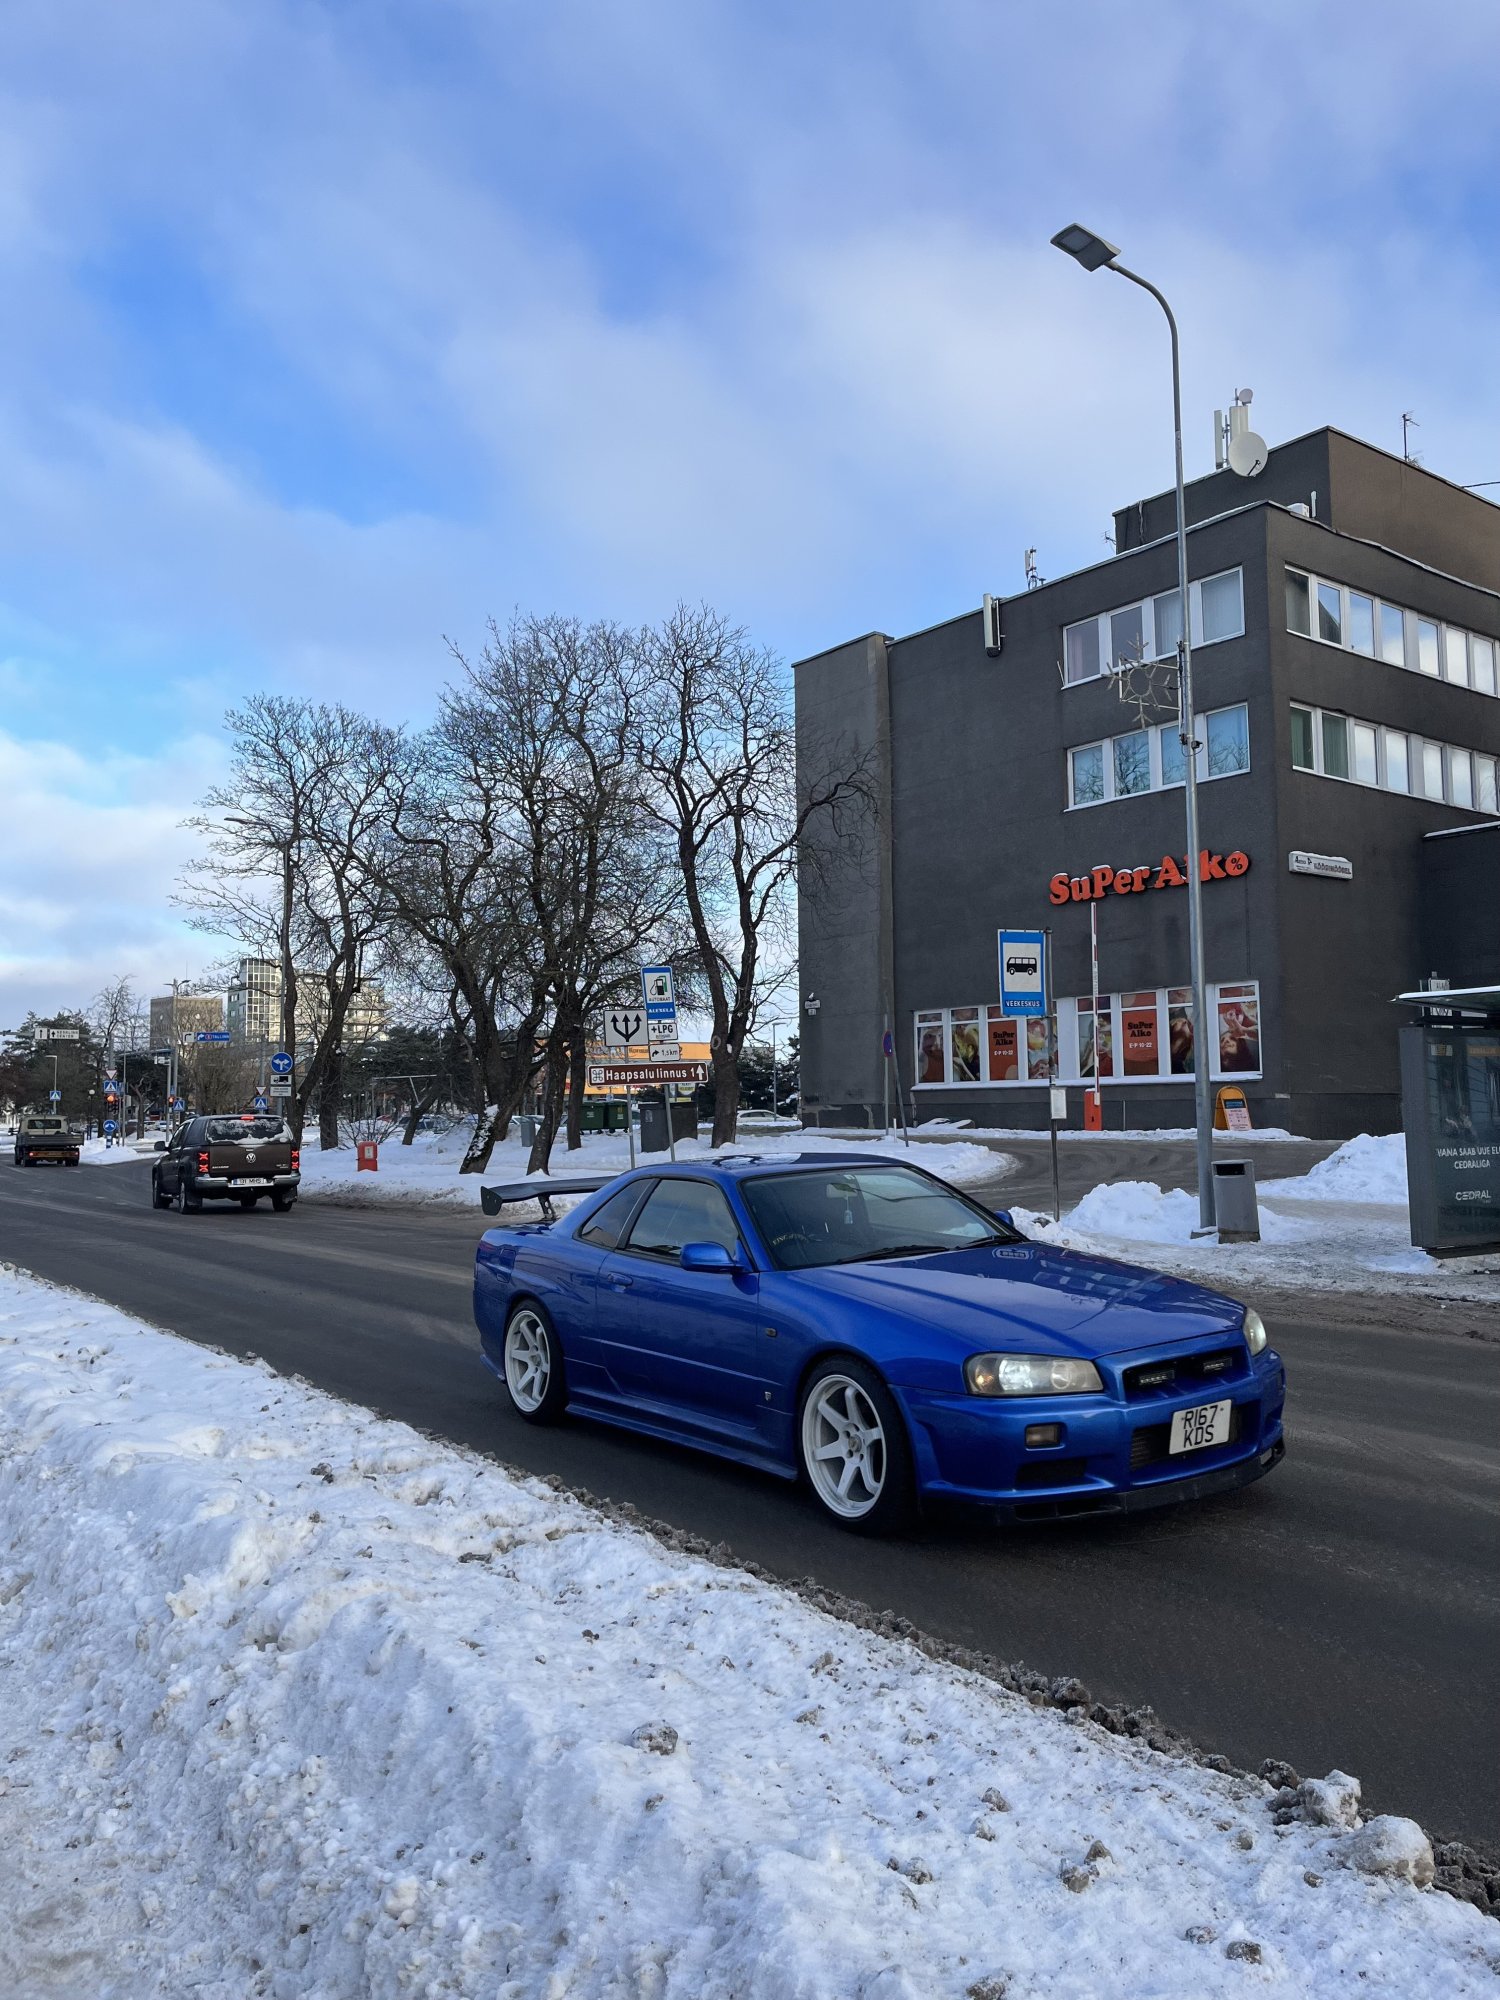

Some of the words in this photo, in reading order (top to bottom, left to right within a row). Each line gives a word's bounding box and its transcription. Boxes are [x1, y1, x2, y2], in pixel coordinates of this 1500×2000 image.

[606, 1068, 655, 1082] Haapsalu
[656, 1068, 687, 1079] linnus
[690, 1067, 695, 1078] 1
[1437, 1148, 1458, 1157] VANA
[1459, 1147, 1476, 1156] SAAB
[1491, 1146, 1500, 1155] EL
[1454, 1160, 1491, 1169] CEDRALIGA
[1455, 1190, 1492, 1201] CEDRAL
[1183, 1424, 1215, 1448] KDS
